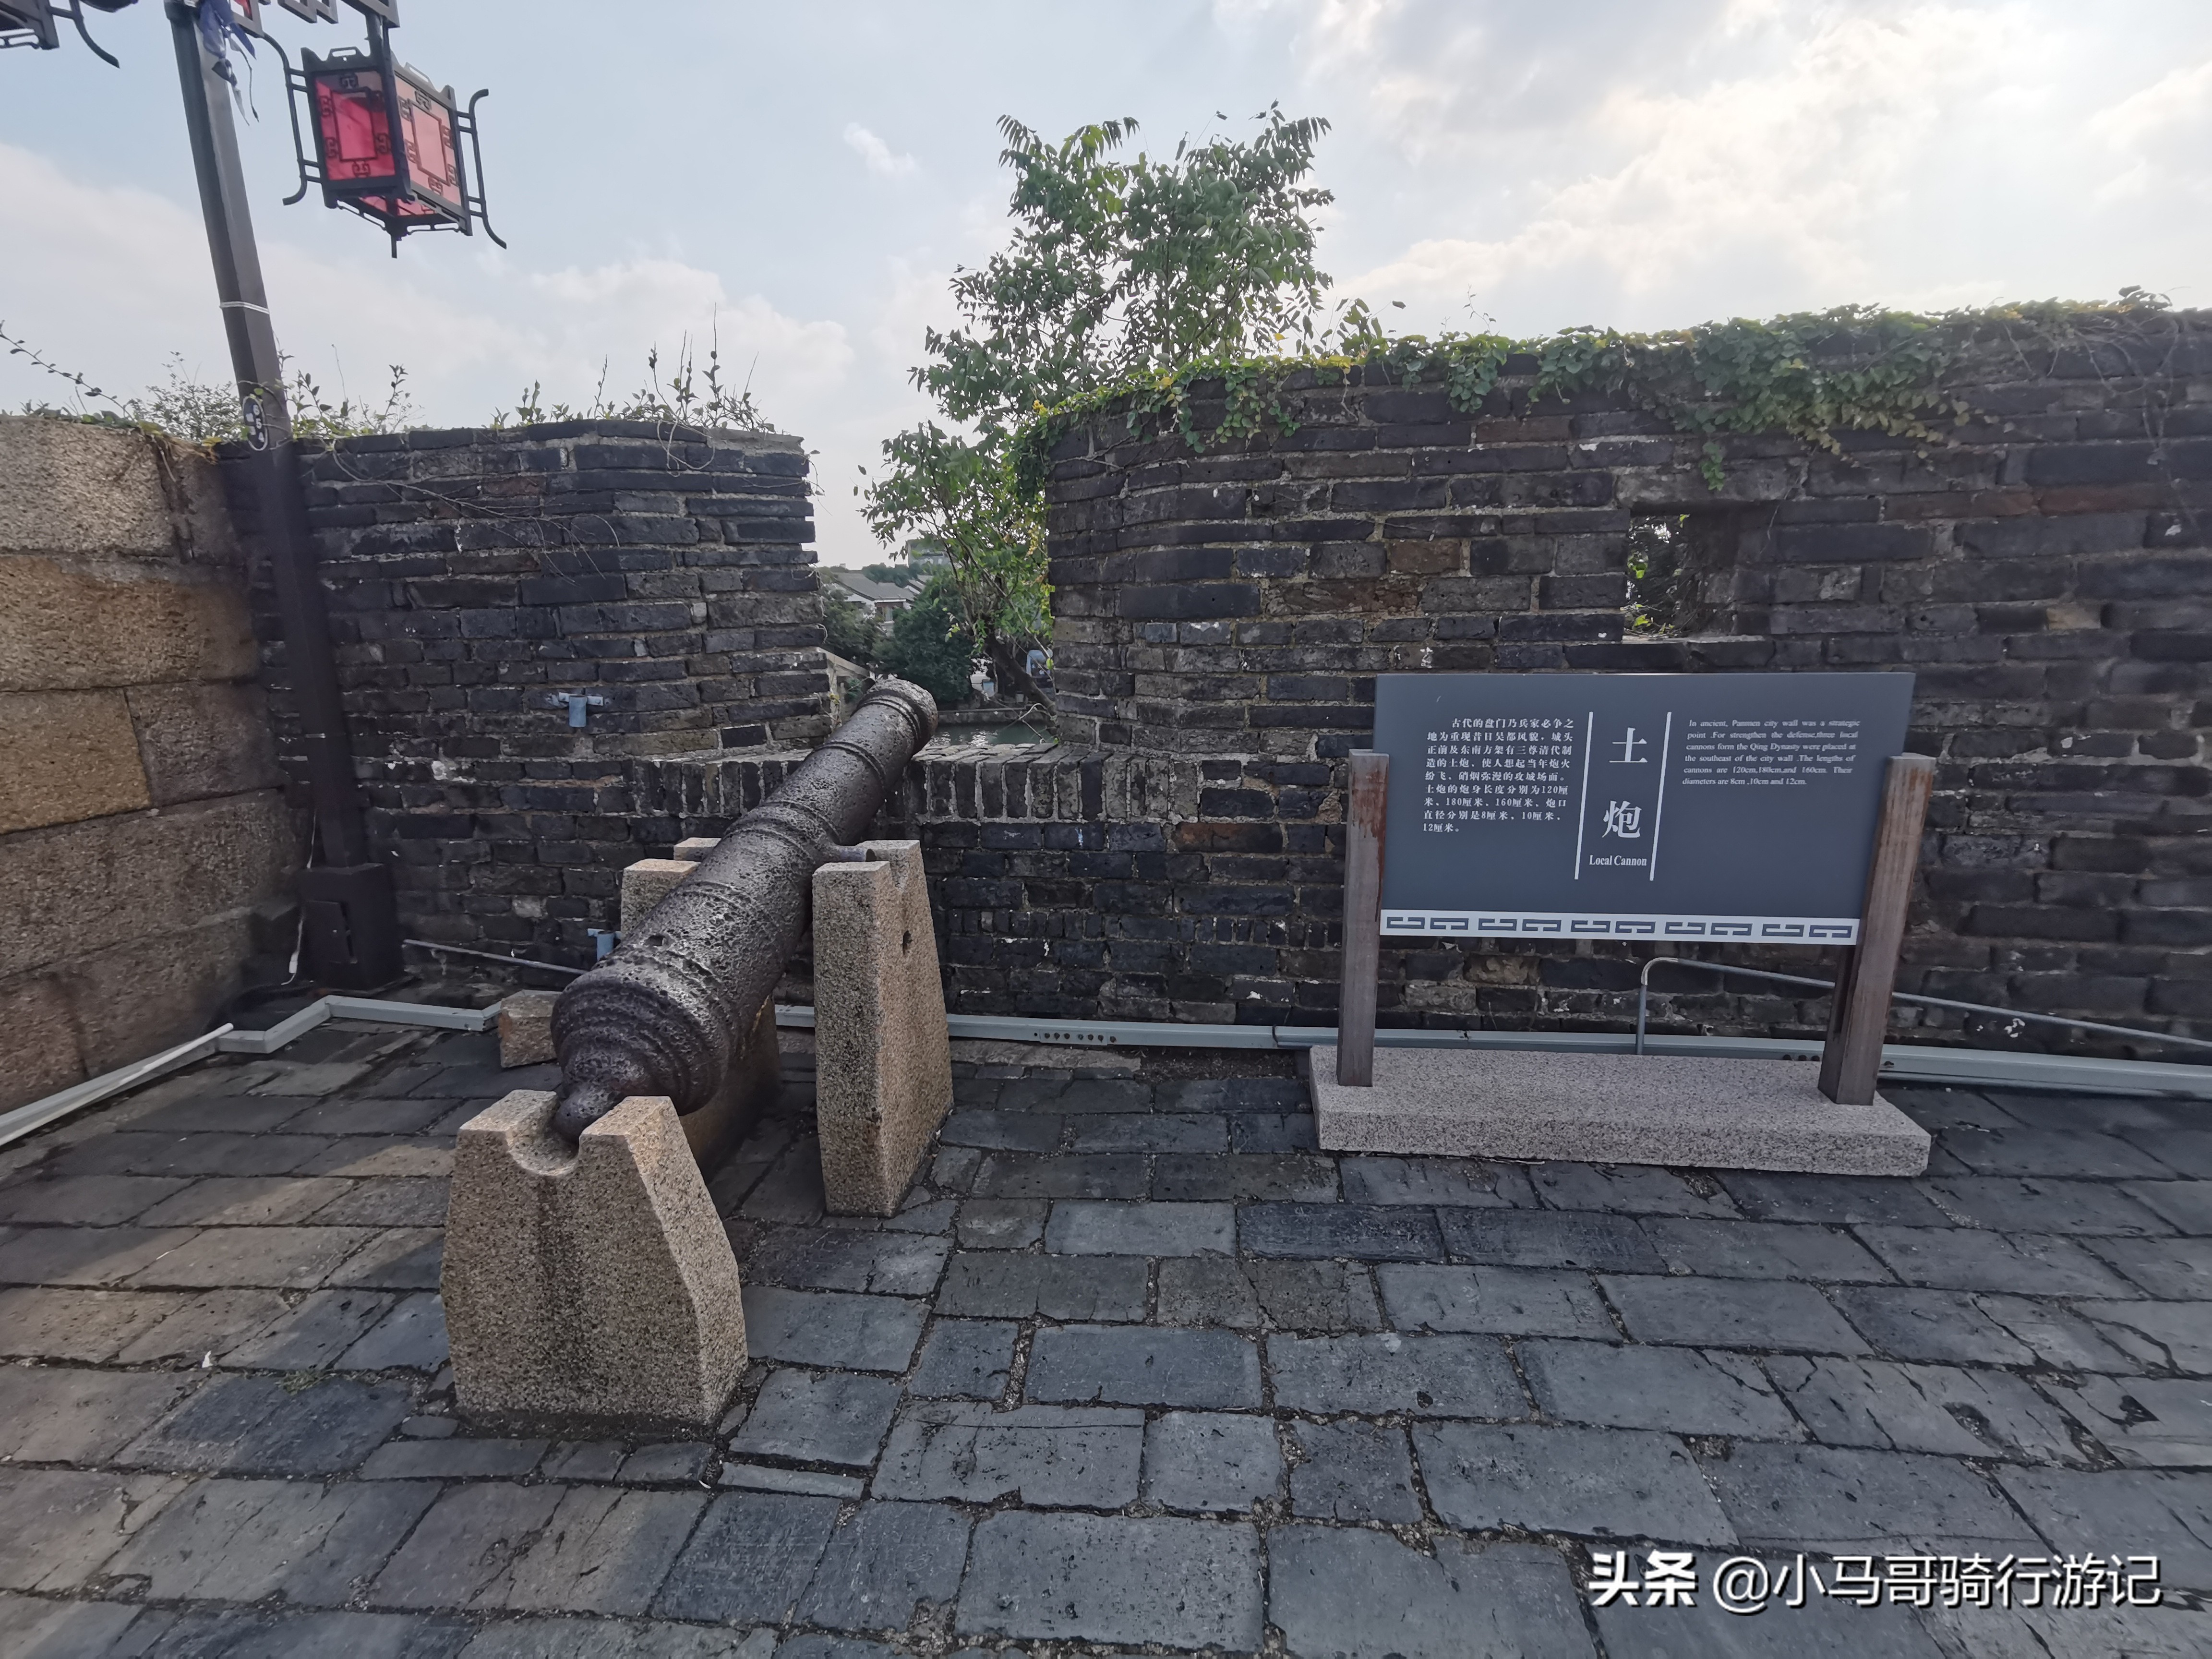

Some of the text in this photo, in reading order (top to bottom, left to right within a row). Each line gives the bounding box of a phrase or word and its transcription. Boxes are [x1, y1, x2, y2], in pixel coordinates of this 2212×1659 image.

[1452, 718, 1574, 728] 古代的盘门乃兵家必争之
[1764, 720, 1779, 728] city
[1730, 732, 1767, 740] strengthen
[1750, 743, 1768, 751] Qing
[1770, 743, 1800, 751] Dynasty
[1602, 727, 1647, 838] 土炮
[1589, 854, 1647, 866] Local Cannon
